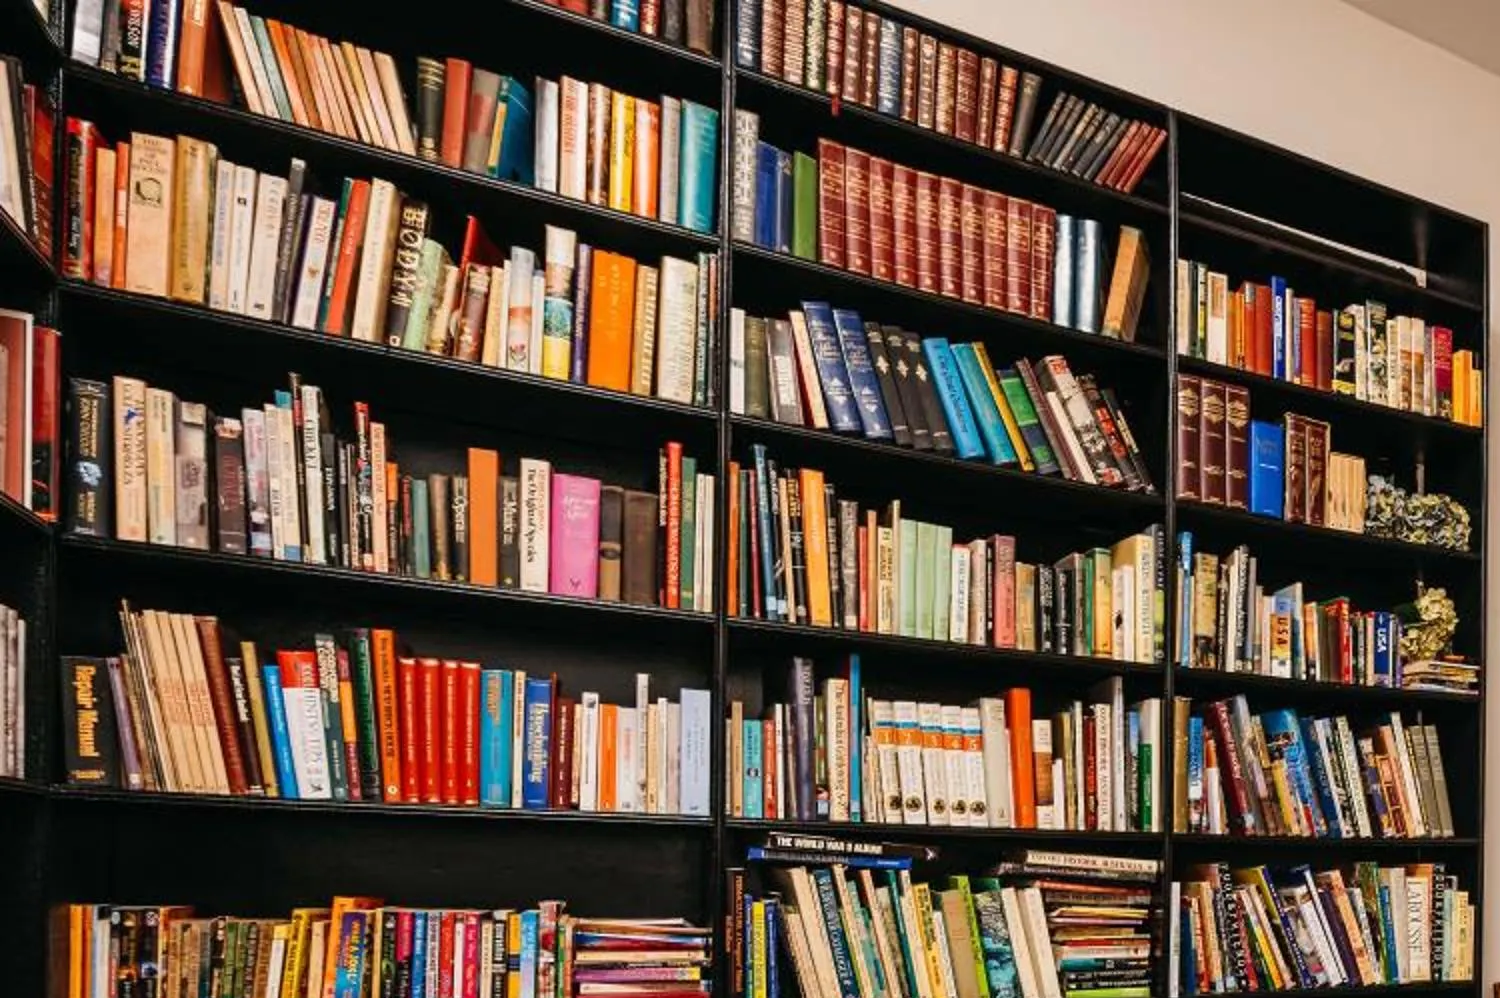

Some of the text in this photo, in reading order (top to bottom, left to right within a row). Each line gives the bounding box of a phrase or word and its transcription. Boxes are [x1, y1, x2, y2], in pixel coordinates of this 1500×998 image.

[1276, 616, 1289, 645] USA
[1376, 627, 1387, 653] USA
[72, 664, 100, 757] Repair Manual
[776, 836, 793, 847] THE
[794, 838, 824, 849] WORLD
[826, 841, 845, 852] WAR
[853, 843, 883, 855] ALBUM
[1407, 880, 1423, 953] LAROUSSE
